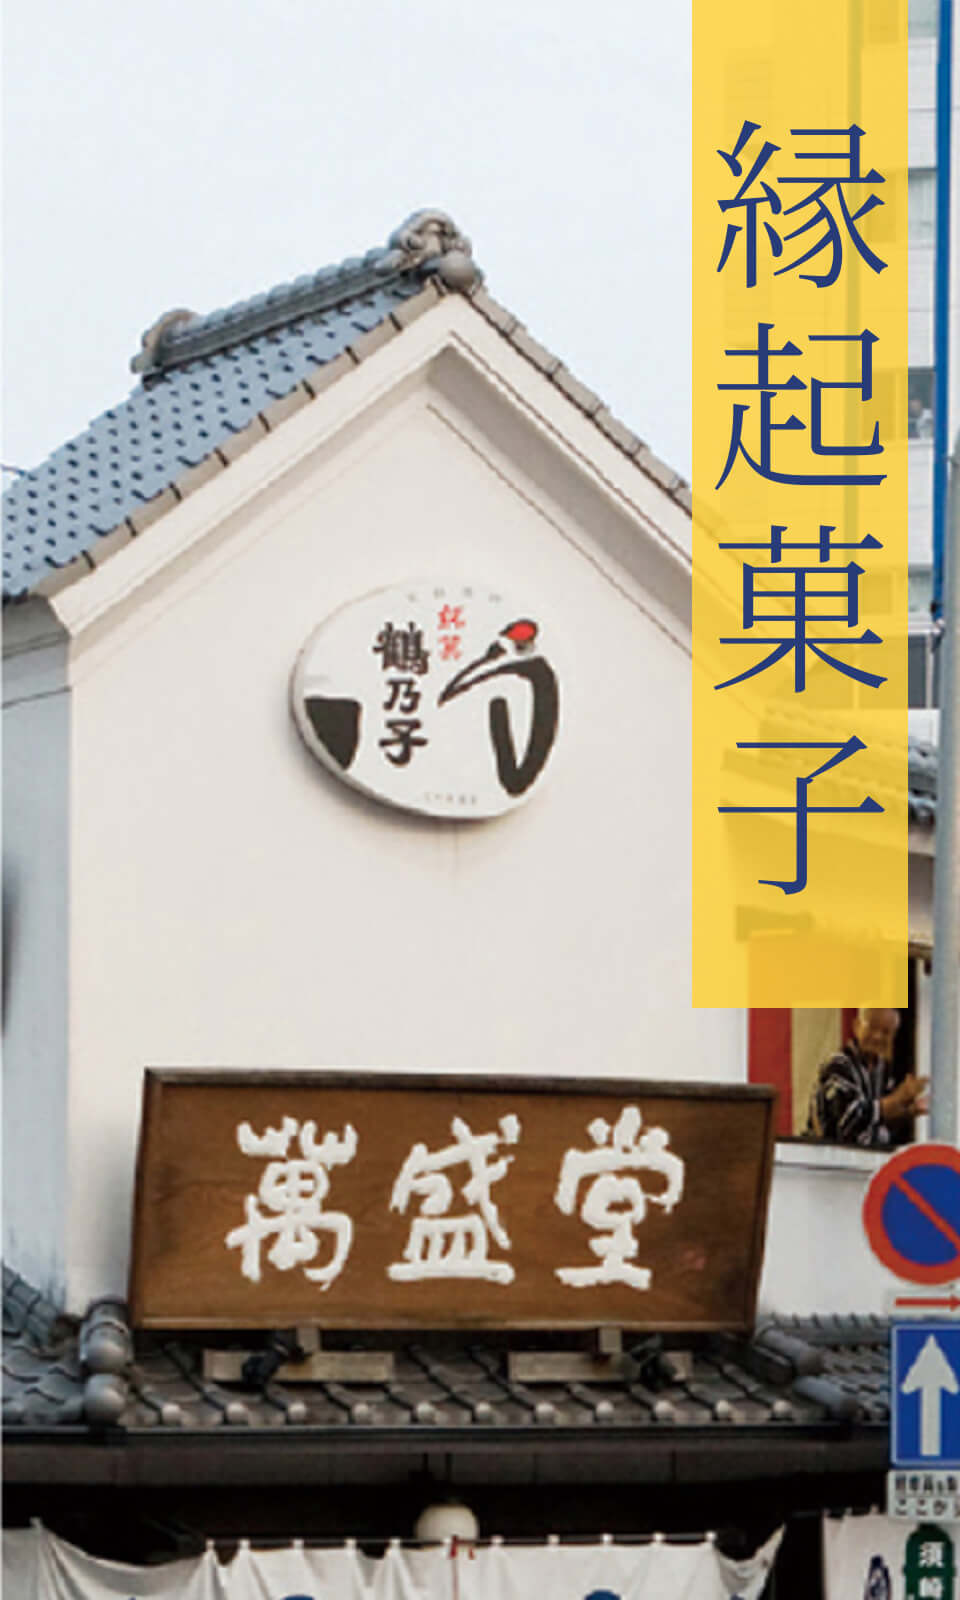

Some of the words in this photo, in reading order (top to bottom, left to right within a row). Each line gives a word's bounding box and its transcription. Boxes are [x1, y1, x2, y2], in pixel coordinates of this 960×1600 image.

[372, 621, 430, 767] 鶴乃子
[225, 1107, 684, 1291] 萬盛堂
